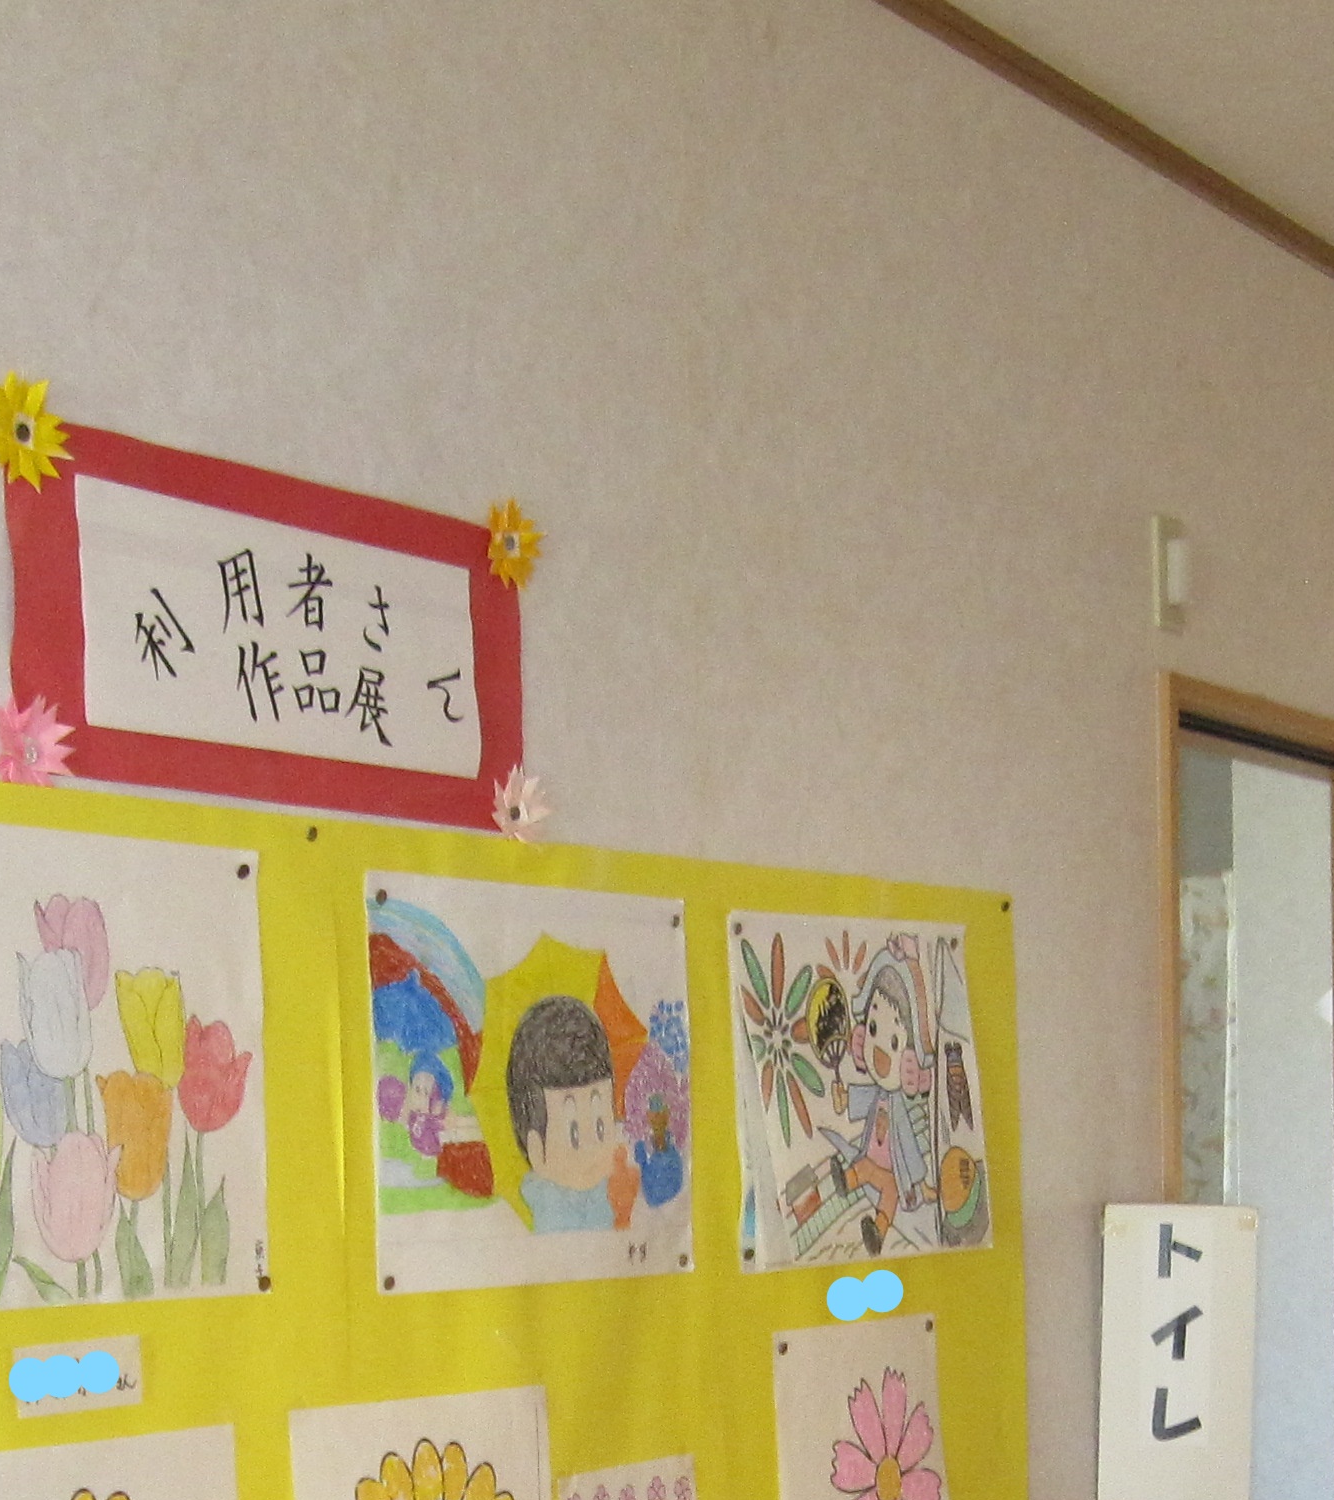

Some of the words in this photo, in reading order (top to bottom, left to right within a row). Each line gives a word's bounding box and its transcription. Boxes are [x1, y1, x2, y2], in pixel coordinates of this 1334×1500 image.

[236, 640, 394, 747] 作品展
[1151, 1222, 1203, 1442] トイレ
